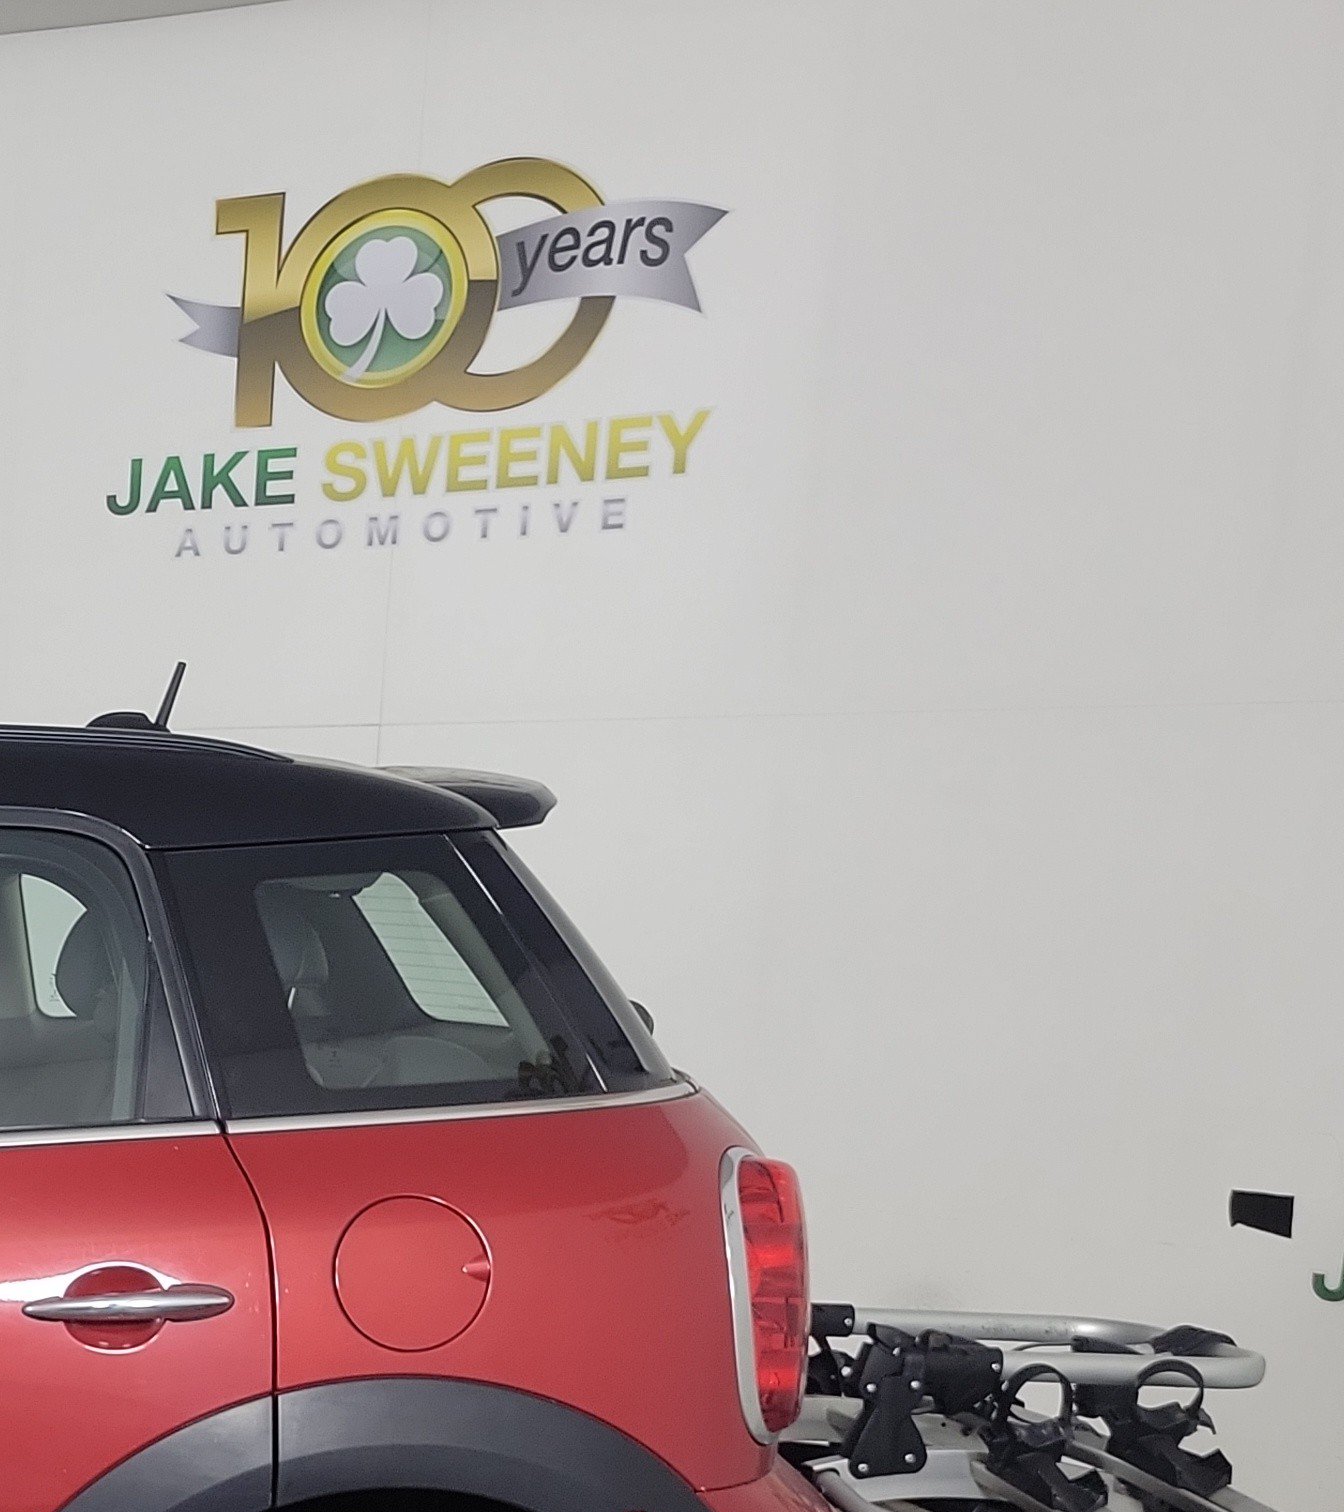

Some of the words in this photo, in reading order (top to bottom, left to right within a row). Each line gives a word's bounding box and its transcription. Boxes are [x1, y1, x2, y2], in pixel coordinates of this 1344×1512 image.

[216, 157, 616, 429] 100
[512, 215, 674, 296] years
[106, 447, 298, 516] JAKE
[321, 409, 711, 503] SWEENEY
[175, 498, 628, 558] AUTOMOTIVE
